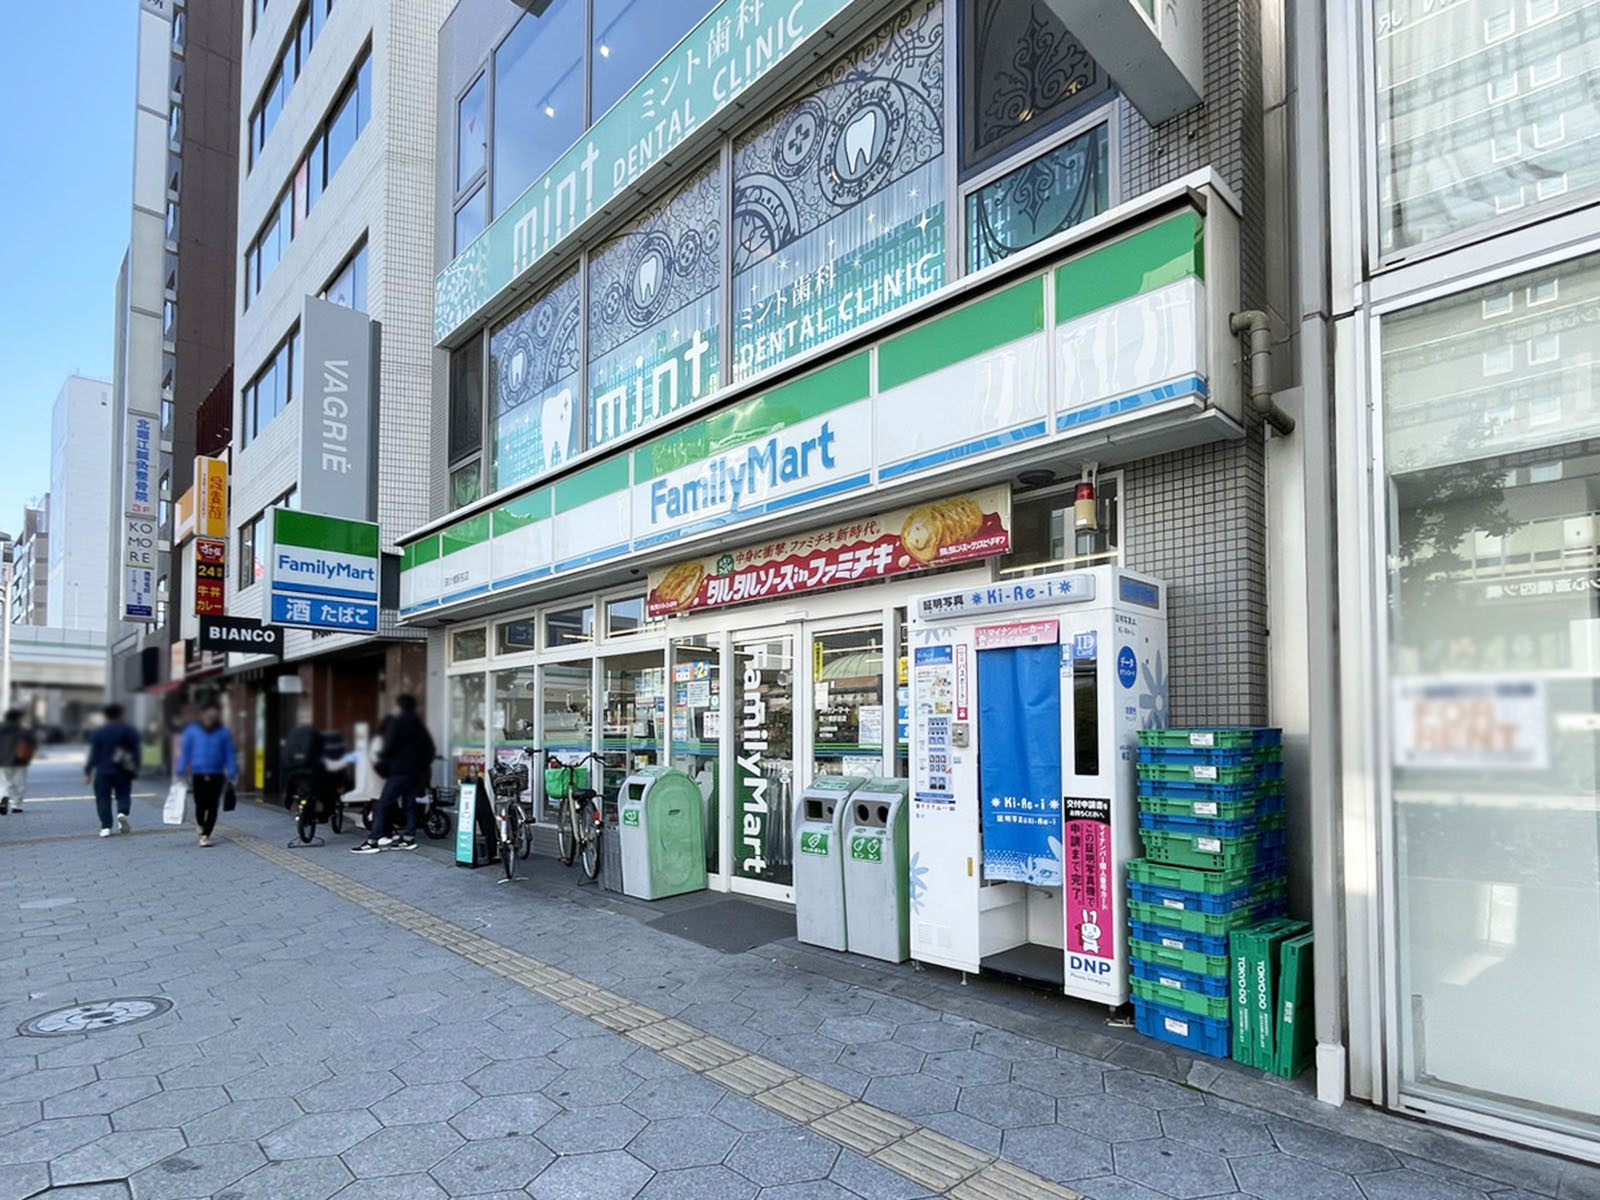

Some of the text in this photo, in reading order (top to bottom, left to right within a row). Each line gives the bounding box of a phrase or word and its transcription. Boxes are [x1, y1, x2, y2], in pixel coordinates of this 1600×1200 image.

[640, 0, 764, 119] ミント歯科
[612, 1, 805, 188] DENTAL CLINIC
[511, 140, 600, 262] mint
[740, 258, 837, 330] ミント歯科
[740, 252, 938, 370] DENTAL CLINIC
[595, 329, 711, 443] mint
[322, 359, 352, 474] VAGRIÉ
[650, 418, 836, 525] FamilyMart
[129, 521, 153, 534] KO
[128, 536, 153, 549] MO
[129, 551, 151, 563] RE
[278, 554, 375, 582] FamilyMart
[706, 542, 894, 606] タルタルソースinファミチキ
[196, 600, 222, 611] カレー
[923, 595, 965, 611] 証明写真
[986, 582, 1053, 605] Ki-Re-i
[285, 598, 369, 625] 酒 たばこ
[209, 626, 276, 643] BIANCO
[988, 622, 1053, 637] マイナンバーカード
[1070, 955, 1111, 975] DNP
